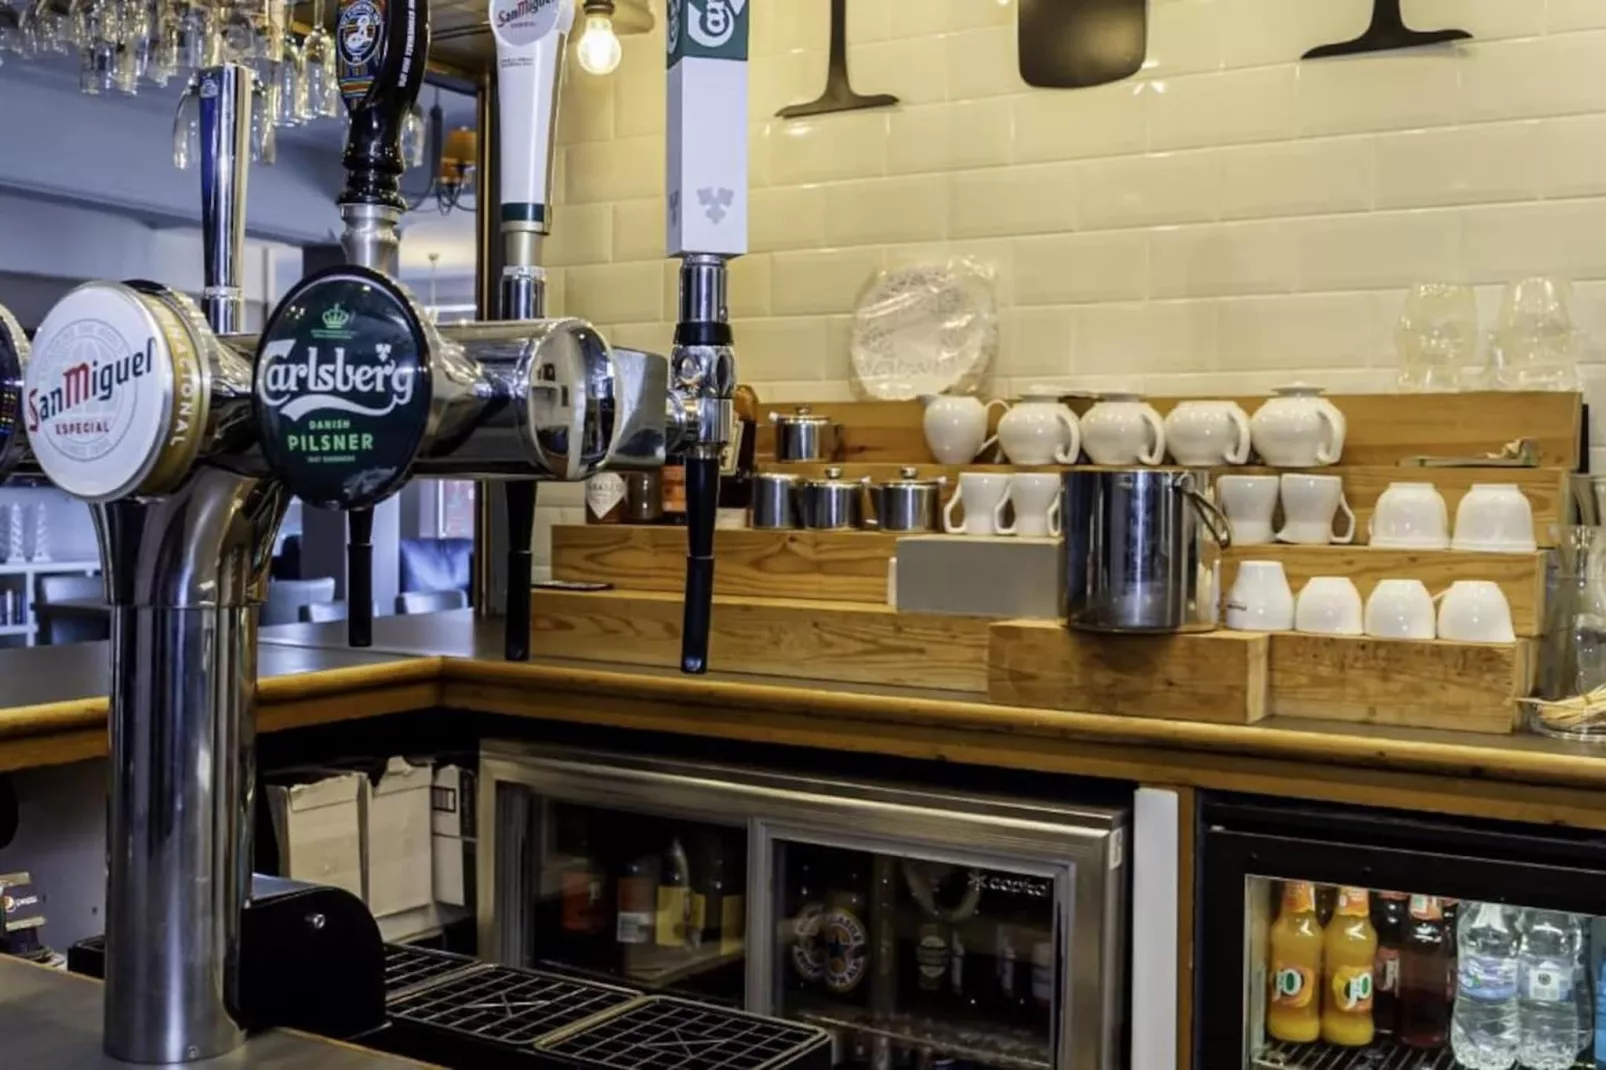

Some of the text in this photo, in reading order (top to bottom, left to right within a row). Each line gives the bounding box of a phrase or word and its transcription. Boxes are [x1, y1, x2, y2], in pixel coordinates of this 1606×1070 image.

[257, 338, 415, 409] Carlsberg
[55, 421, 110, 436] ESPECIAL
[308, 419, 351, 430] DANISH
[287, 433, 374, 451] PILSNER
